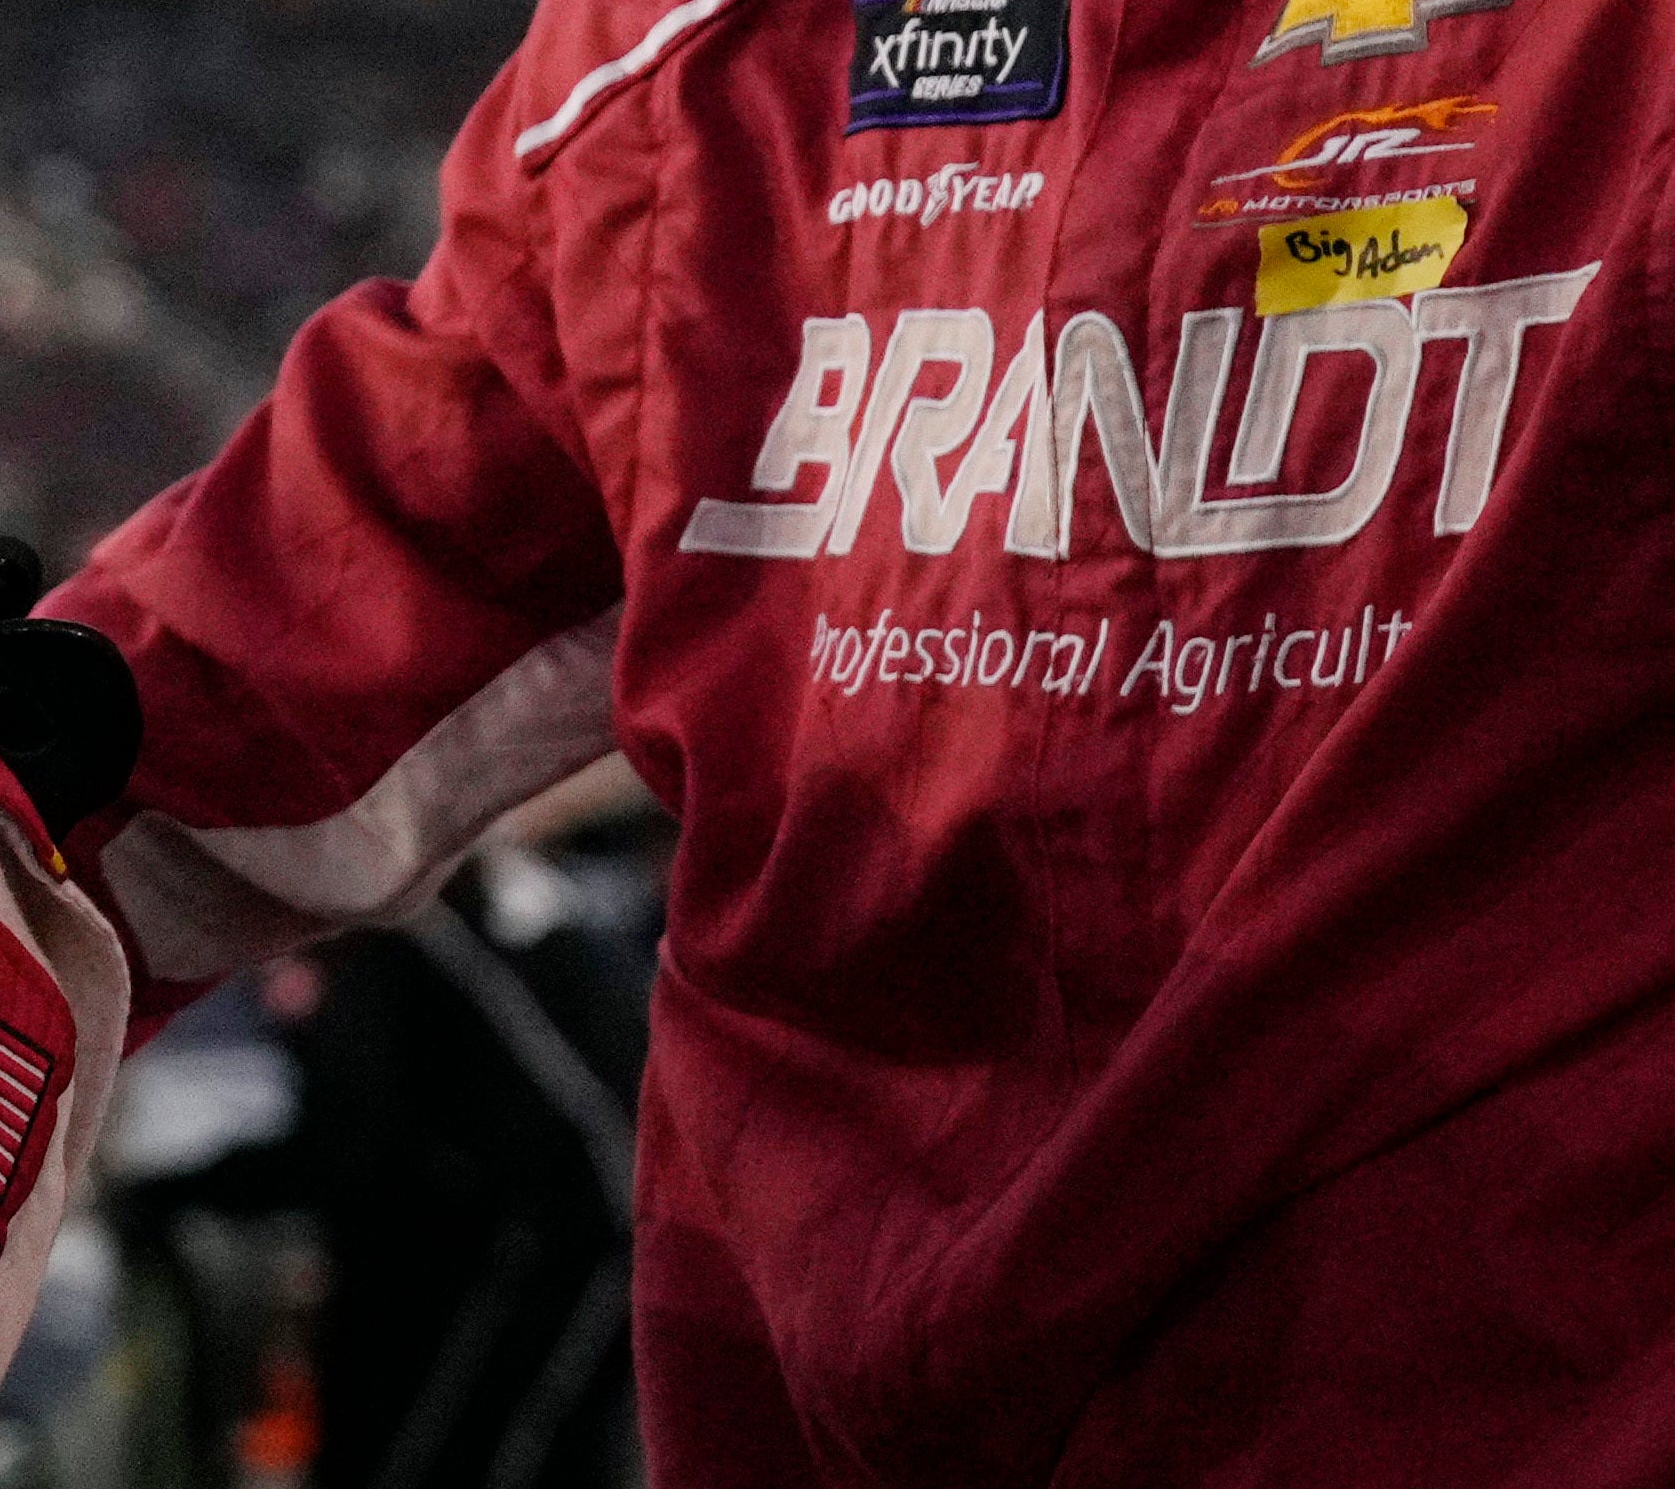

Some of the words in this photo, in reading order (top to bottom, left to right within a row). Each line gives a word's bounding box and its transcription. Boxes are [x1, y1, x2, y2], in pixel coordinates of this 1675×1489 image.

[870, 16, 1028, 88] xfinity
[911, 74, 984, 100] SERIES
[828, 161, 1045, 228] GOODYEAR
[1286, 229, 1352, 277] Big
[1356, 230, 1445, 280] Adam
[678, 261, 1602, 559] BRANDT
